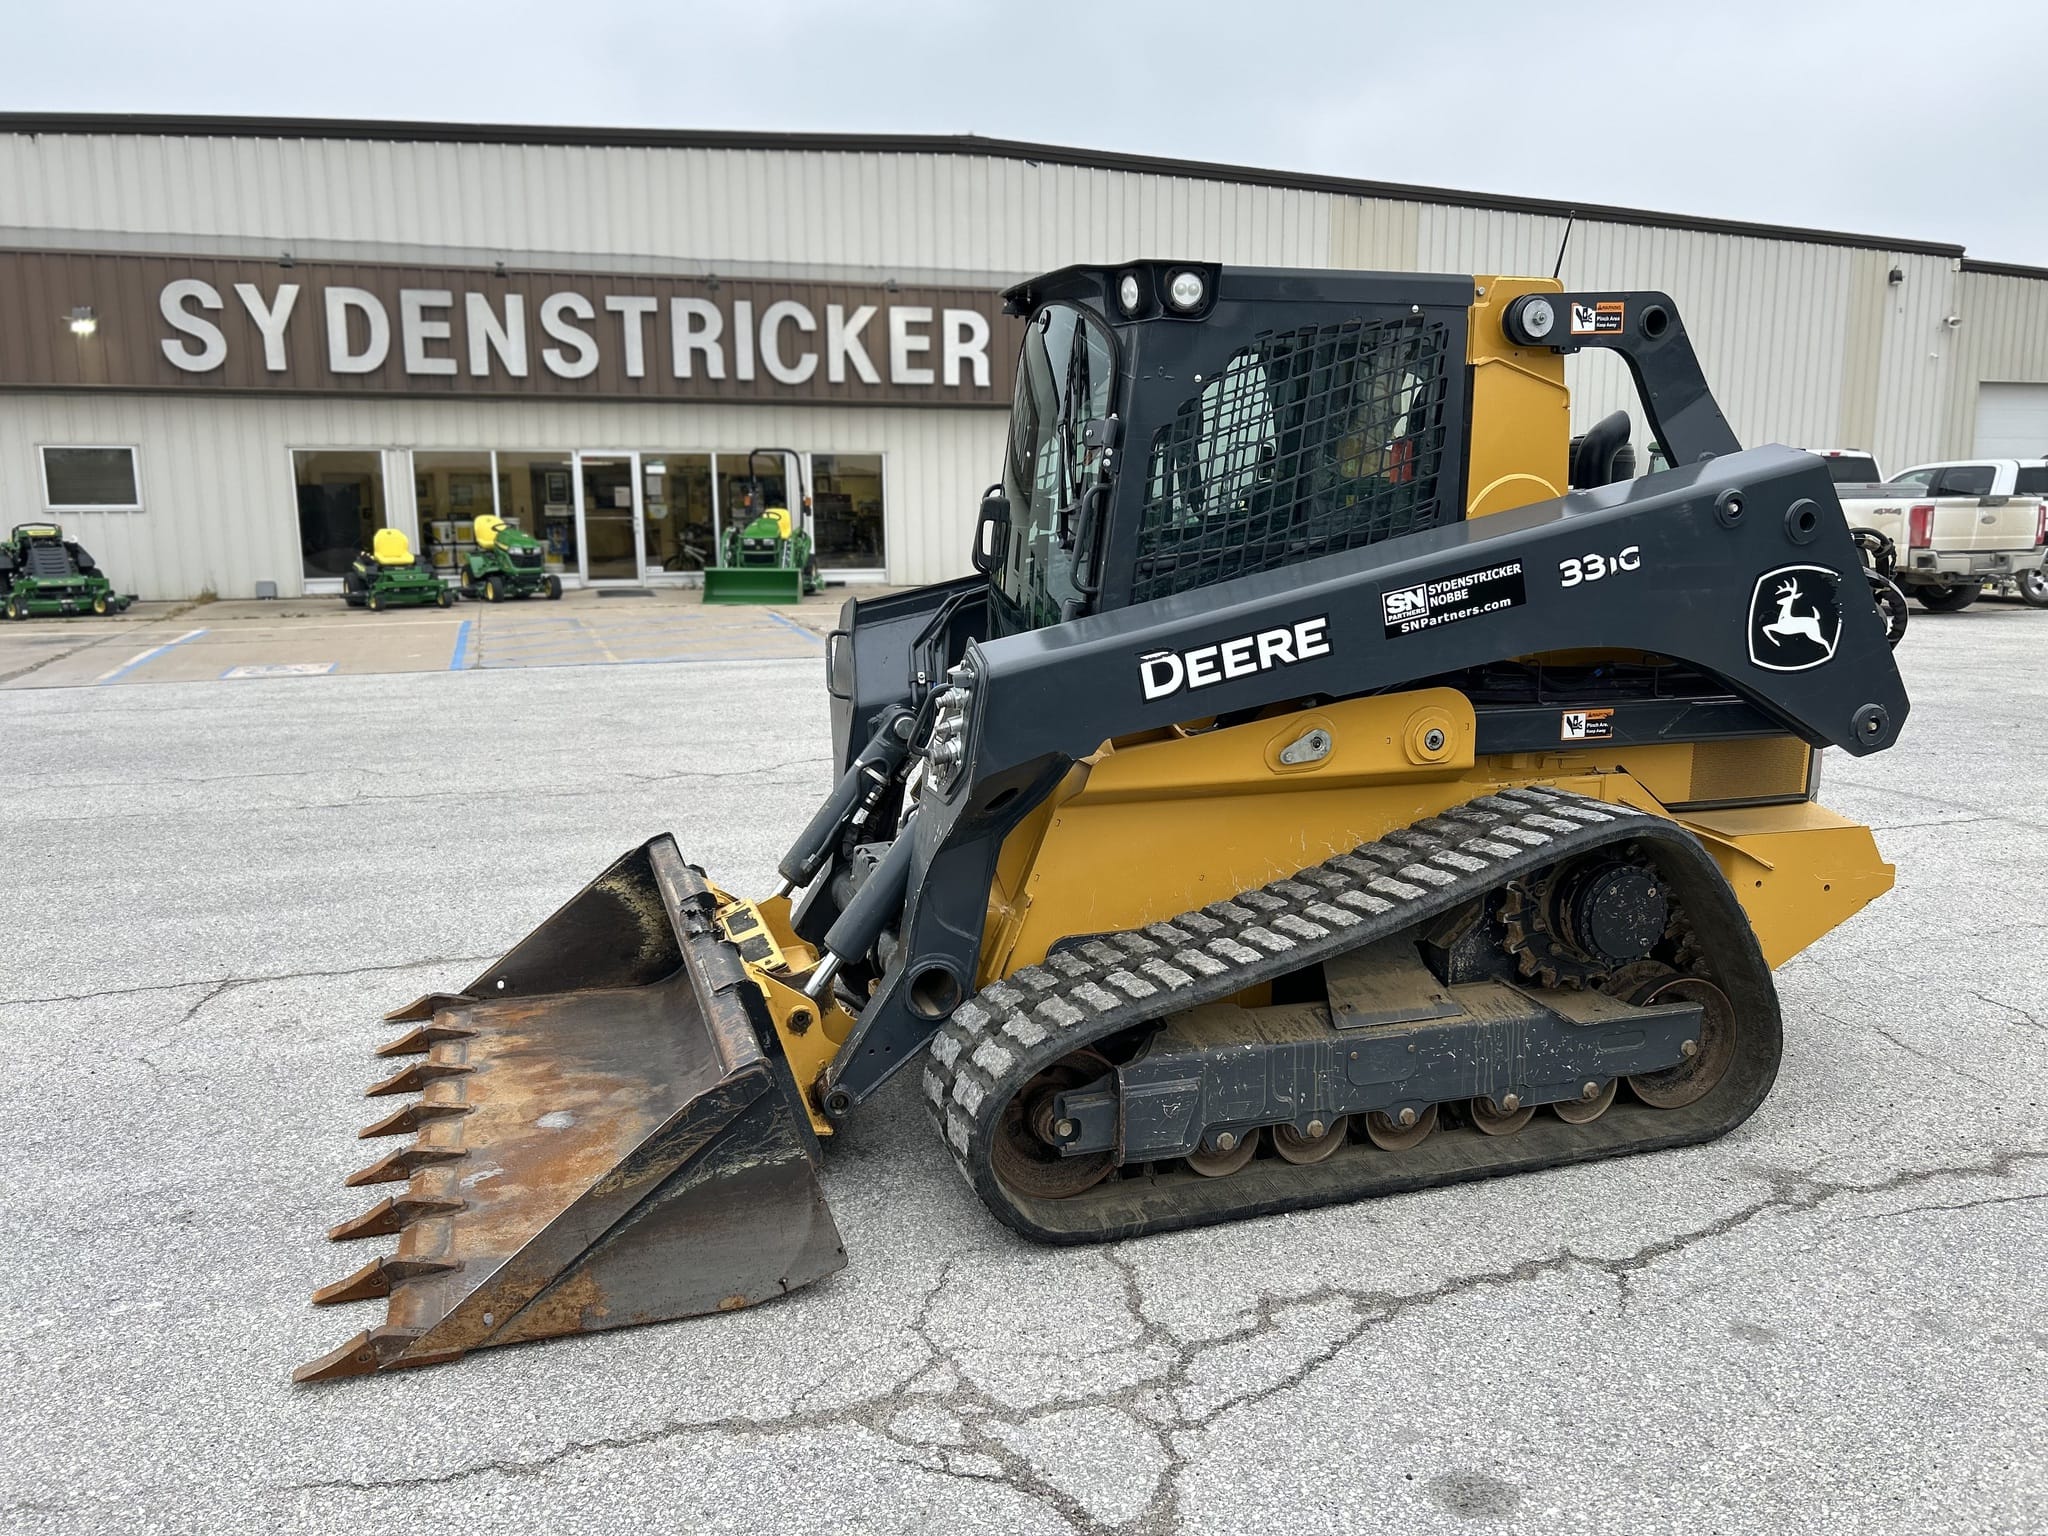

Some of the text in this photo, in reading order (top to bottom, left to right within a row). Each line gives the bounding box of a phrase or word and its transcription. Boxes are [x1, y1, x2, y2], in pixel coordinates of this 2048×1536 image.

[159, 278, 992, 388] SYDENSTRICKER
[1428, 563, 1522, 596] SYDENSTRICKER
[1387, 607, 1426, 622] PARTNERS
[1430, 588, 1469, 608] NOBBE
[1400, 598, 1512, 633] SNPartners.com
[1139, 617, 1330, 701] DEERE
